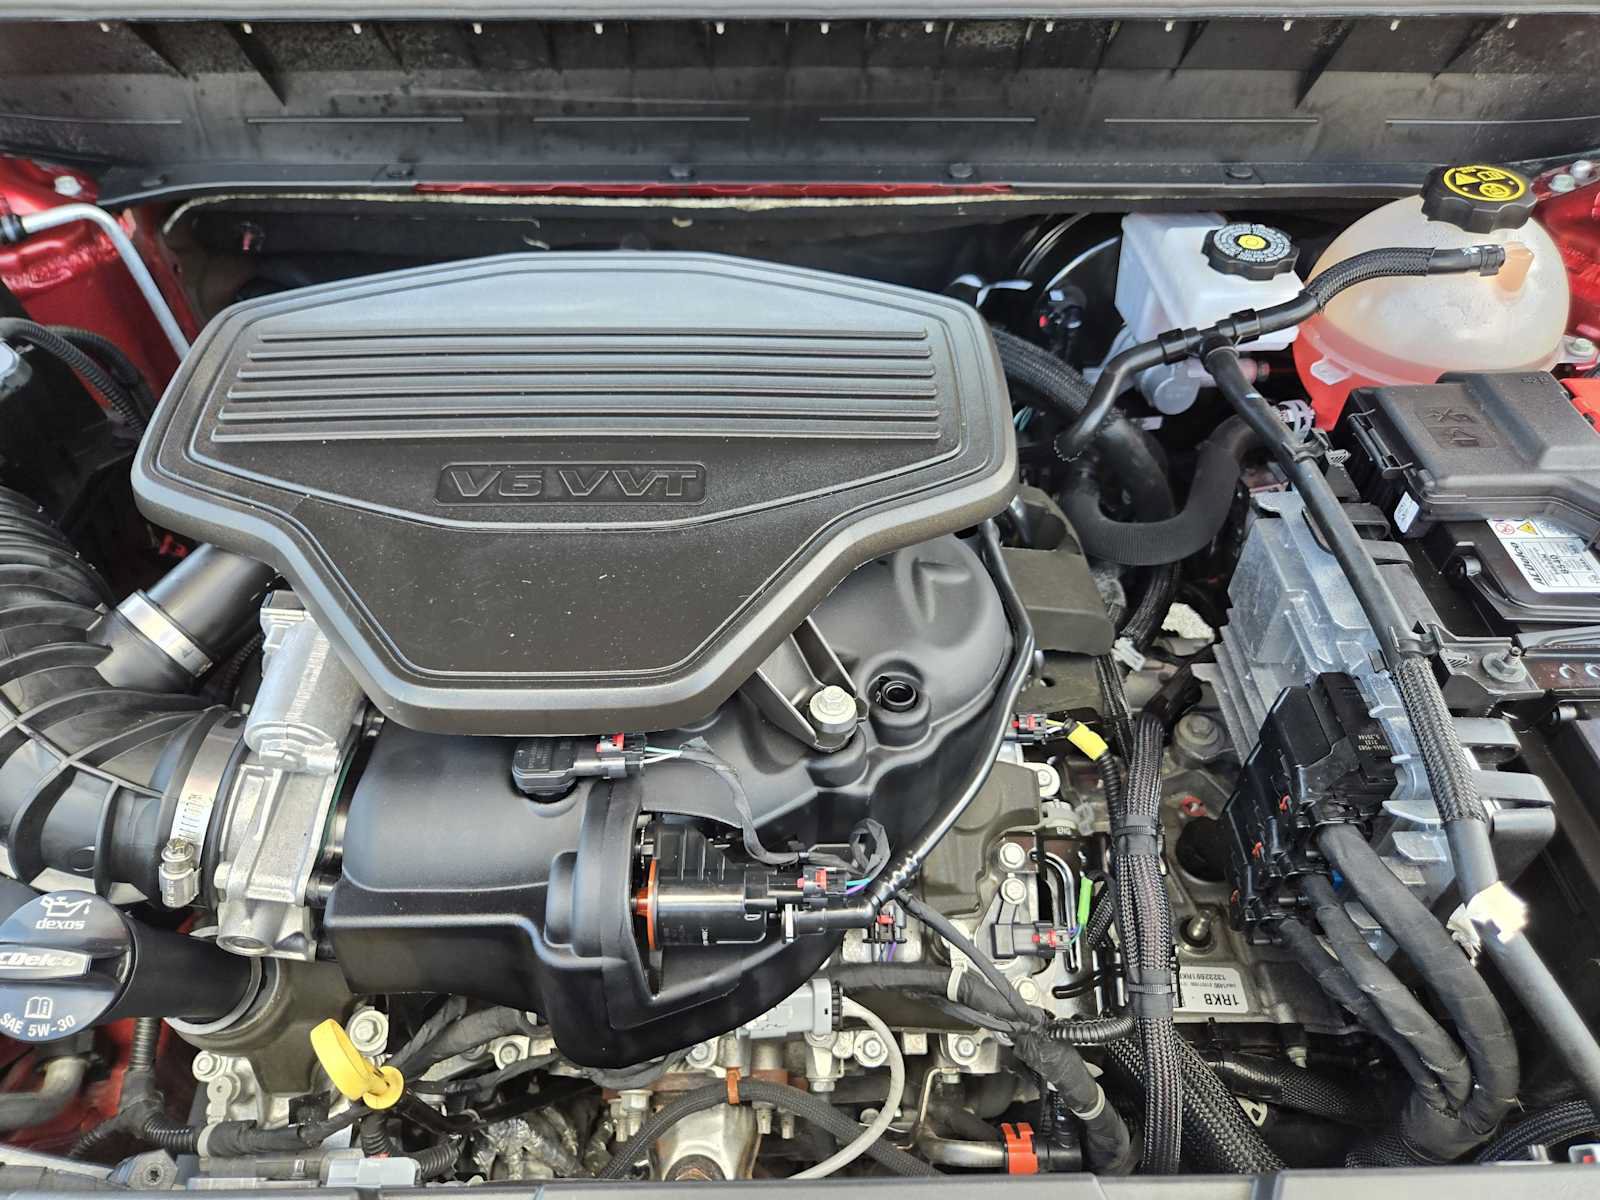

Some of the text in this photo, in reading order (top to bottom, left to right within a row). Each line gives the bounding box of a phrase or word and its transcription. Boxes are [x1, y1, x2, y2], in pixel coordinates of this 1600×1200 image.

[449, 470, 697, 497] V6 VVT
[35, 918, 86, 930] dexos
[0, 1012, 76, 1037] SAE 5W-30
